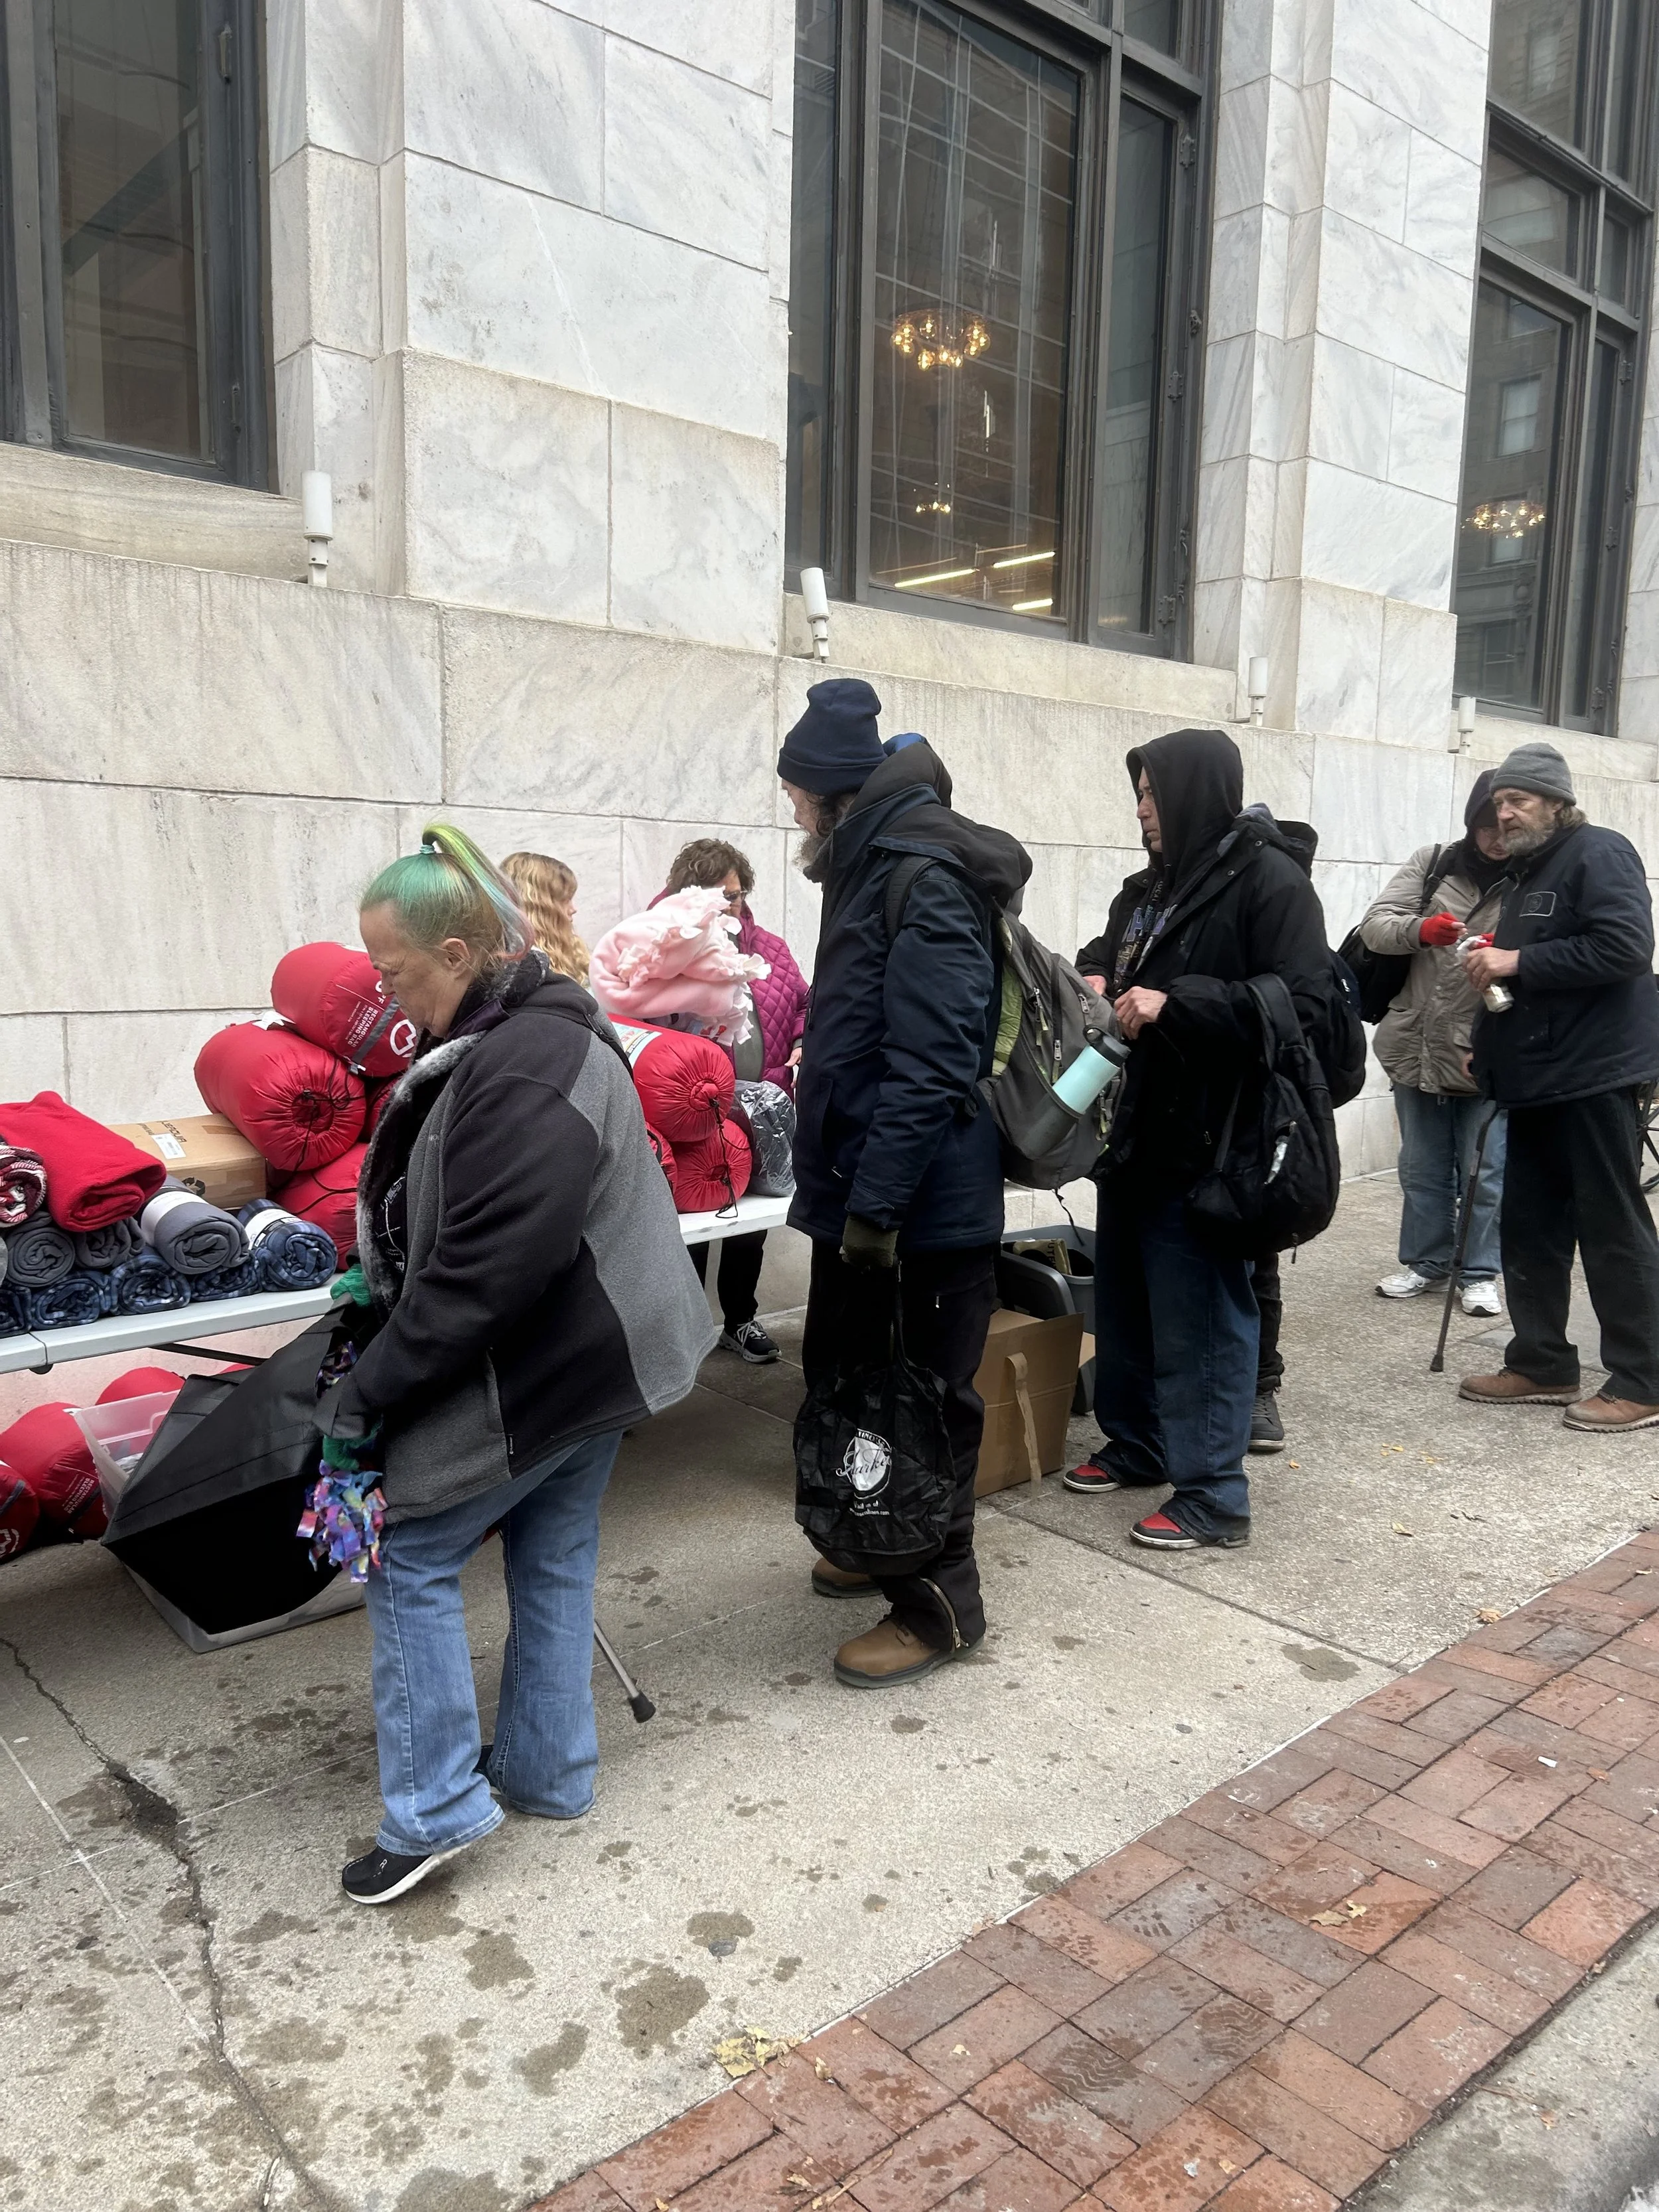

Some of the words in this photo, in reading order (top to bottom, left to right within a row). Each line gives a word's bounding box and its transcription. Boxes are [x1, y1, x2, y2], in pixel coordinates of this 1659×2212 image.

[350, 1009, 378, 1048] RECTANGULAR
[355, 1006, 374, 1034] SLEEPING
[347, 1034, 358, 1045] BAG
